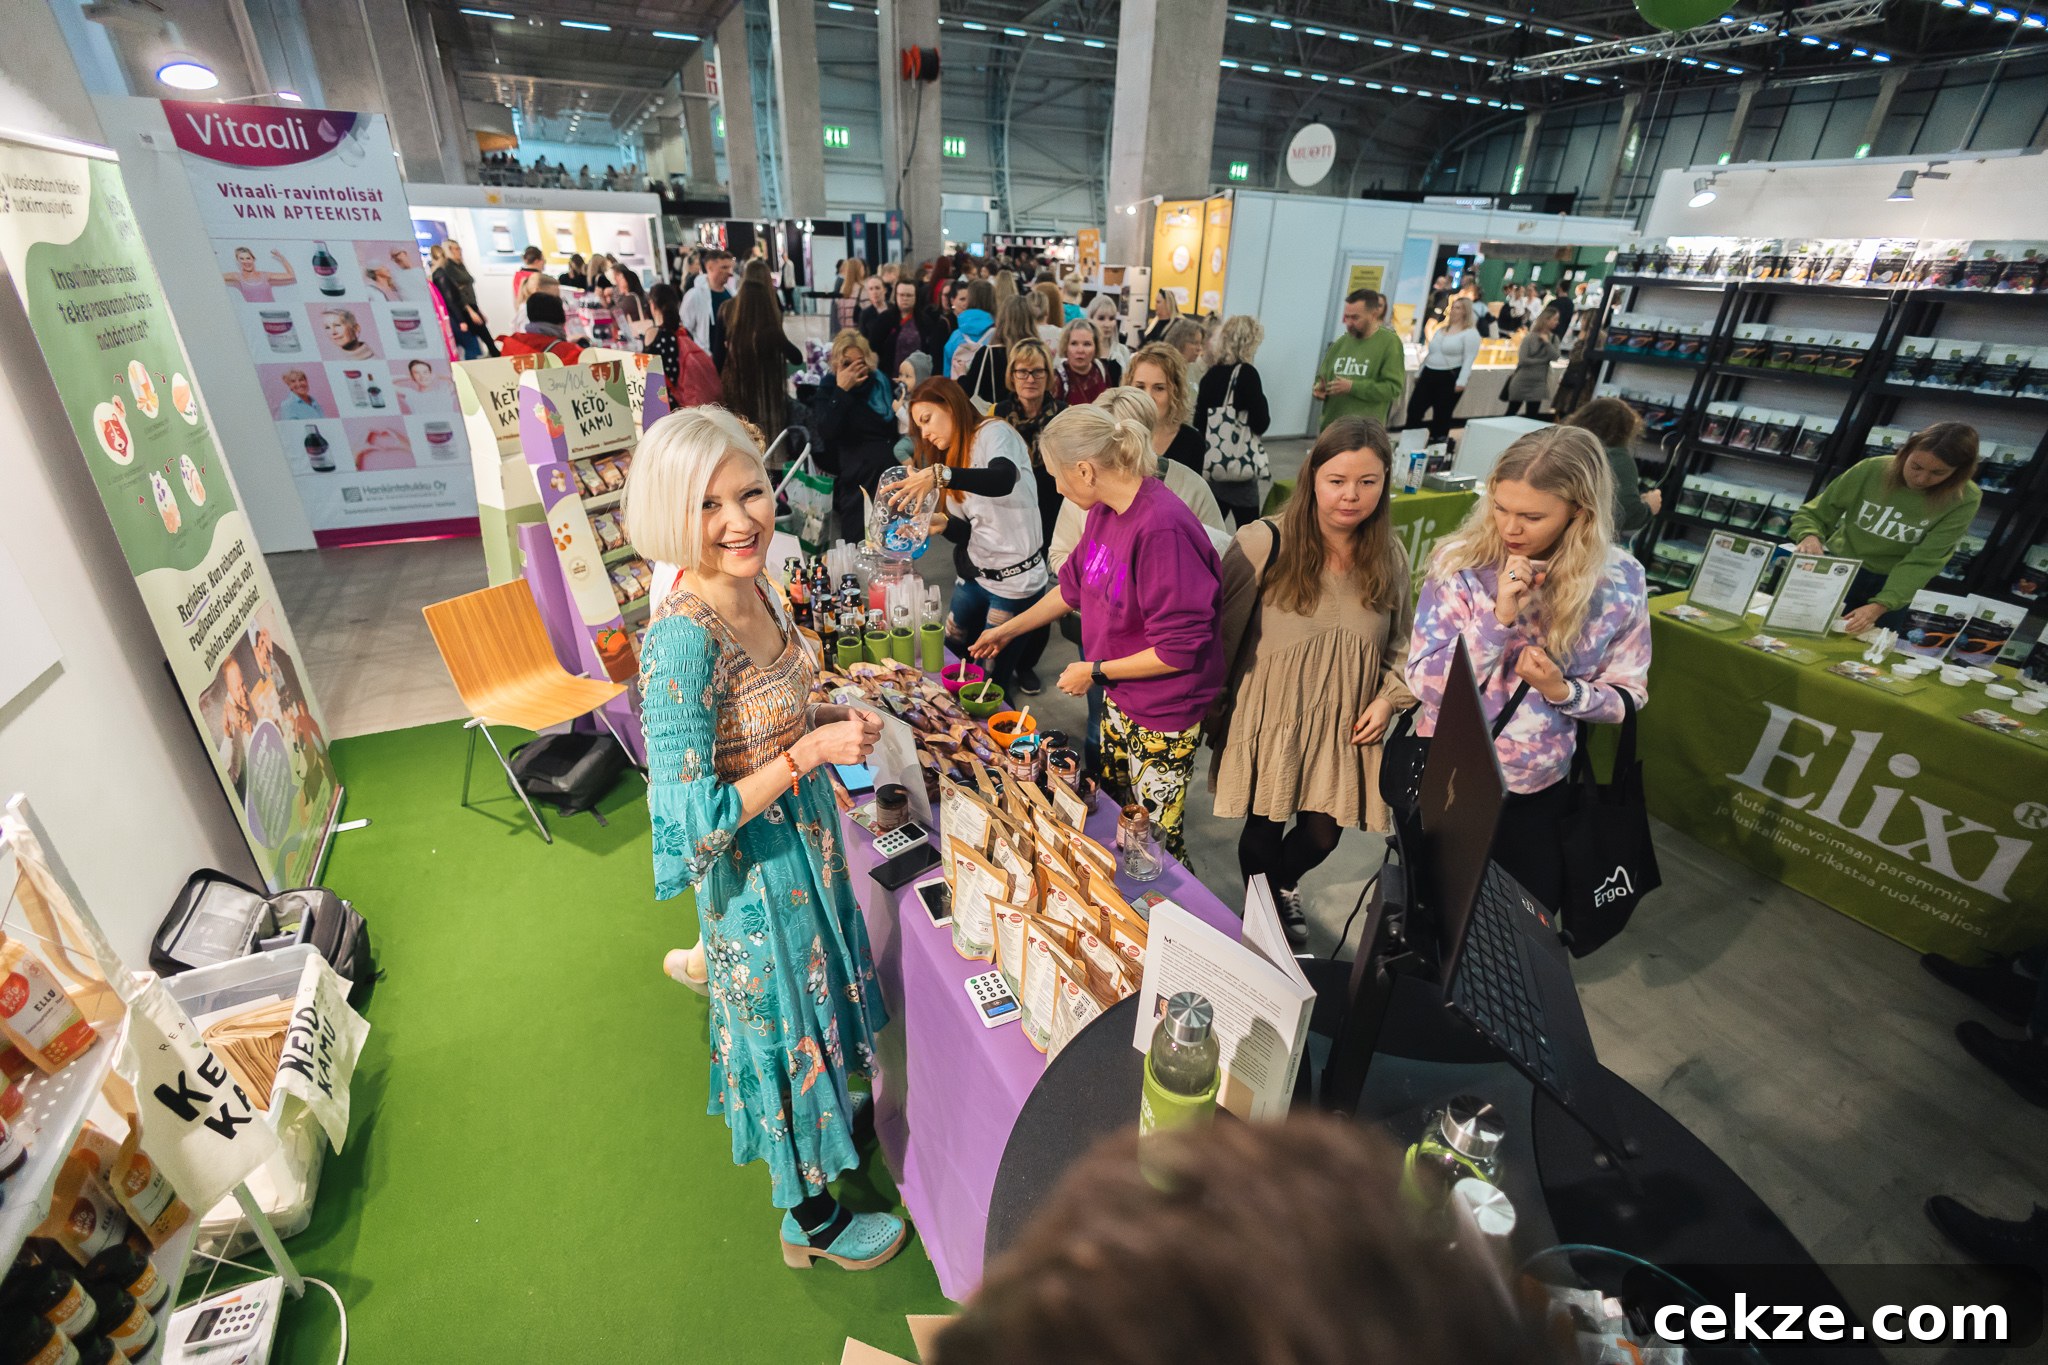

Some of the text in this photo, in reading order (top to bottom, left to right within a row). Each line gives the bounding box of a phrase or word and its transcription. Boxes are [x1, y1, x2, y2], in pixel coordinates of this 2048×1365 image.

[186, 111, 310, 151] Vitaali
[217, 182, 384, 203] Vitaali-ravintolisät
[233, 204, 383, 222] VAIN APTEEKISTA
[1333, 356, 1370, 376] Elixi
[580, 413, 613, 437] KAMU
[1855, 499, 1930, 545] Elixi
[1731, 791, 1805, 833] Autamme
[1808, 825, 1874, 866] voimaan
[1875, 859, 1971, 909] paremmin
[1715, 804, 1990, 940] jo lusikallinen rikastaa ruokavaliosi
[1594, 886, 1627, 908] Ergo
[34, 988, 57, 1013] ELLU
[317, 1015, 337, 1100] KAMU
